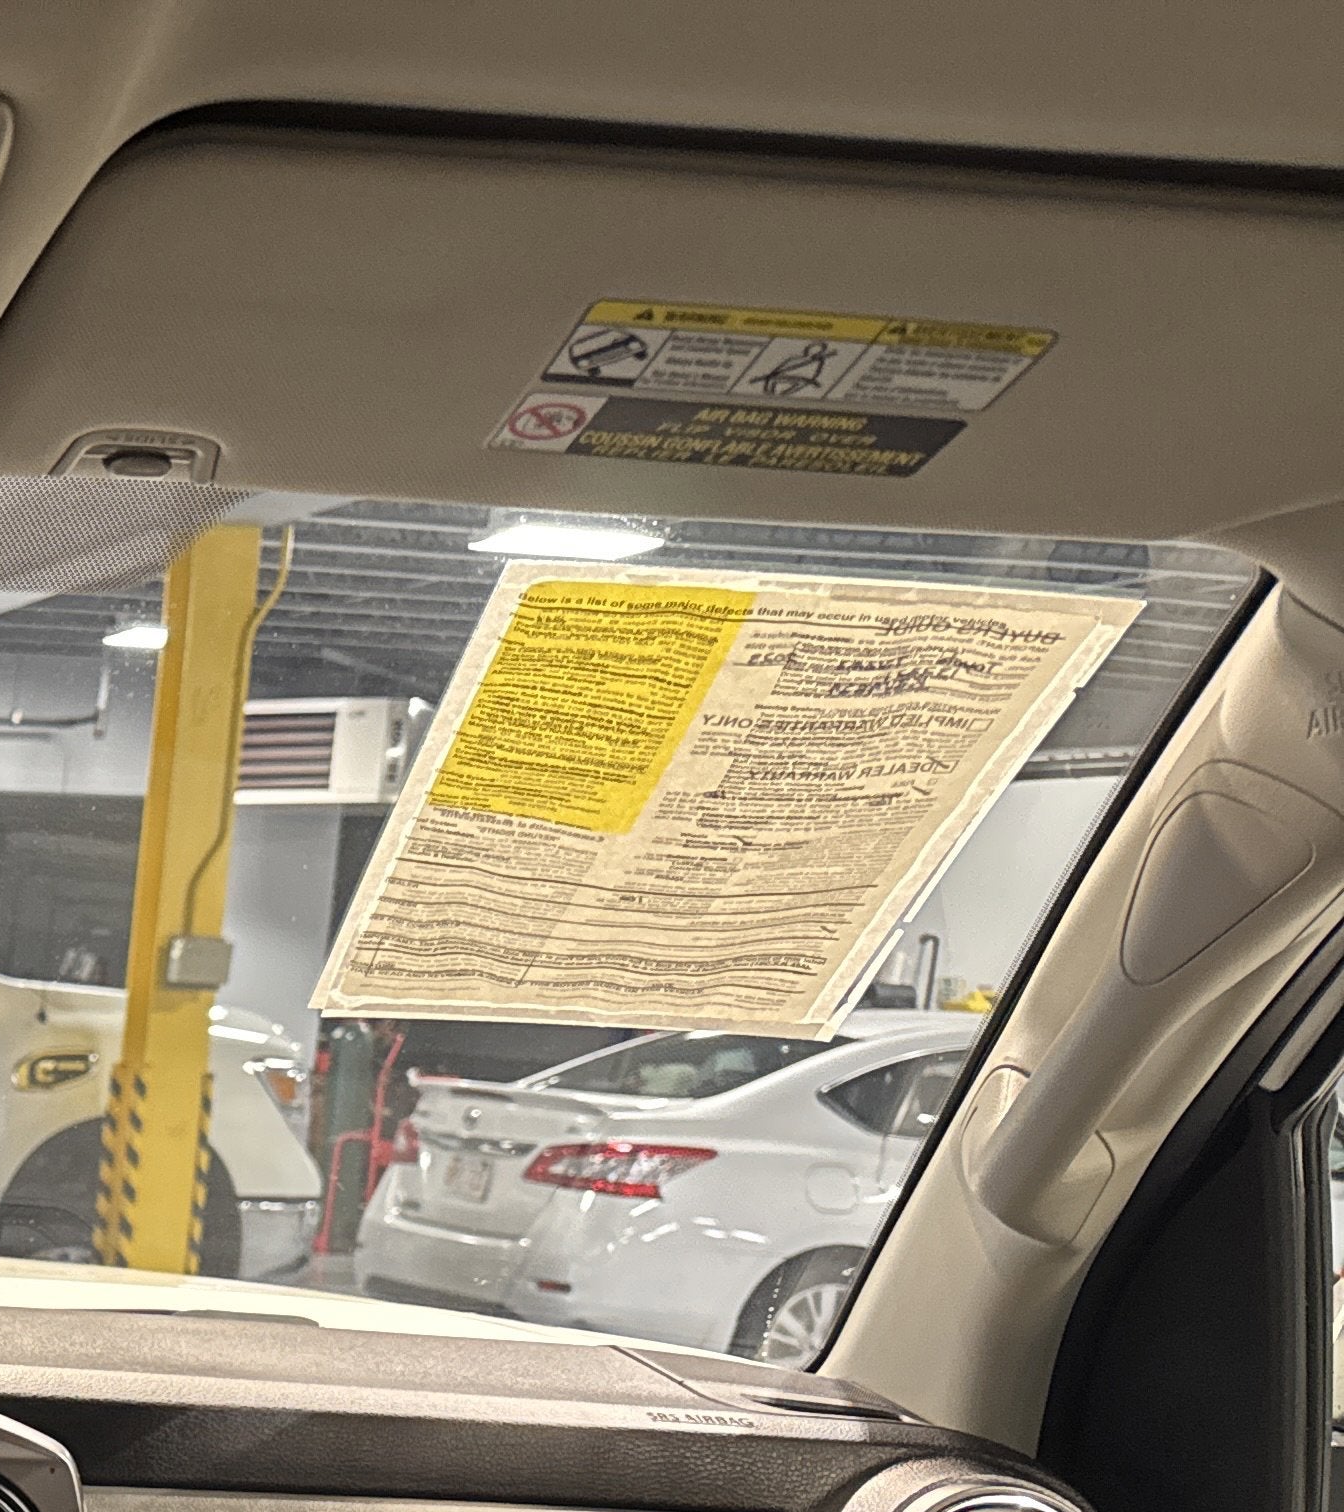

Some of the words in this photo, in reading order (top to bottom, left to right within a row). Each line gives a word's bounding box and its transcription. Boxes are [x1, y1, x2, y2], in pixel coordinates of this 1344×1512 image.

[758, 607, 785, 617] that
[786, 609, 815, 620] may
[859, 613, 872, 622] in
[685, 1414, 755, 1428] AIRBAG
